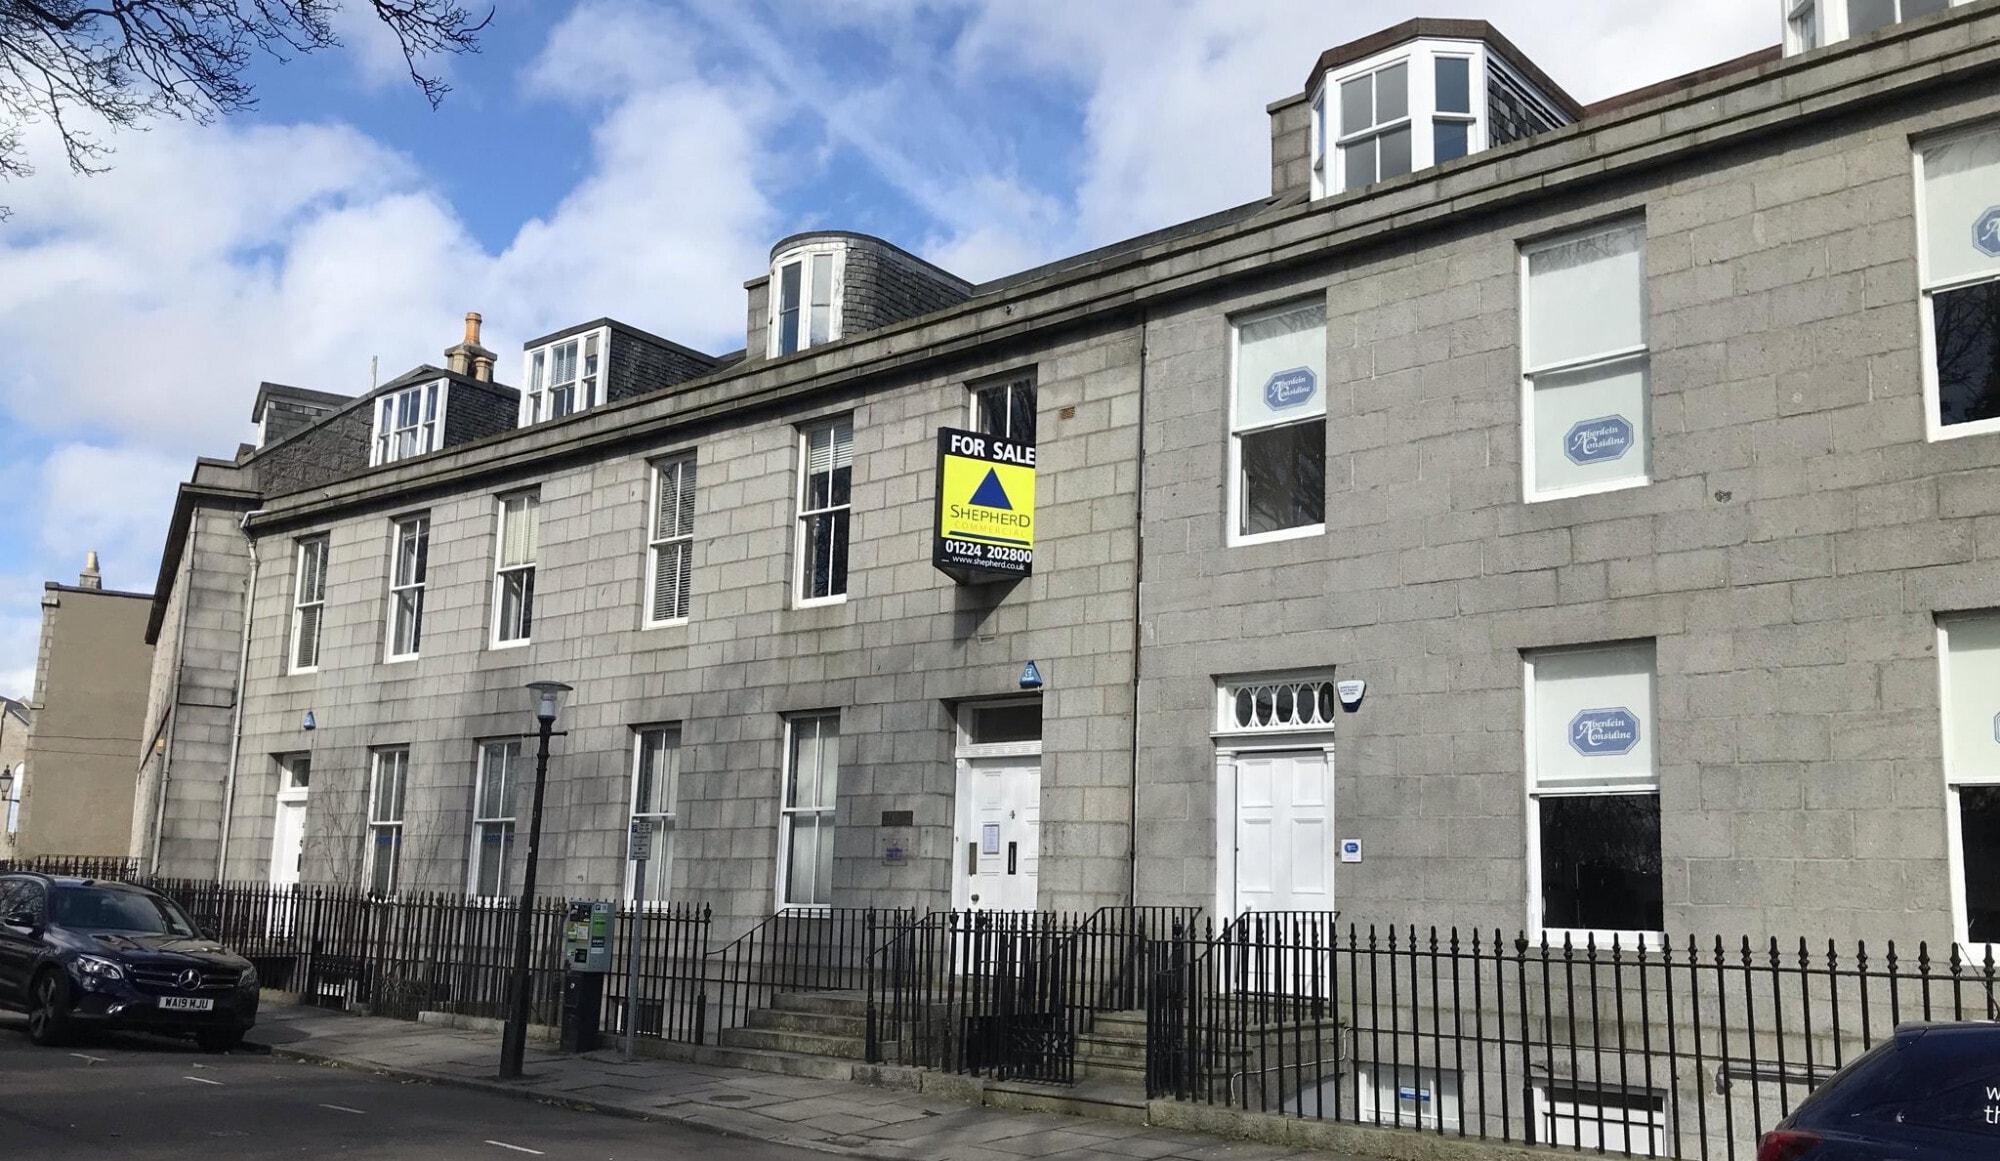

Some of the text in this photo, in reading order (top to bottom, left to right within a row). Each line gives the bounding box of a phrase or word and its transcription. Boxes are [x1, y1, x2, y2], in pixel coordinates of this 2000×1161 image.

[1571, 426, 1618, 450] Aberdein
[1583, 436, 1625, 454] Considine
[951, 434, 1035, 465] FOR SALE
[950, 504, 1031, 528] SHEPHERD
[954, 520, 1025, 538] COMMERCIAL
[945, 540, 1032, 563] 01224 202800
[952, 555, 1025, 571] www.shepherd.co.uk
[1575, 718, 1625, 740] Aberdein
[1587, 728, 1631, 746] Considine
[165, 997, 188, 1008] WA19
